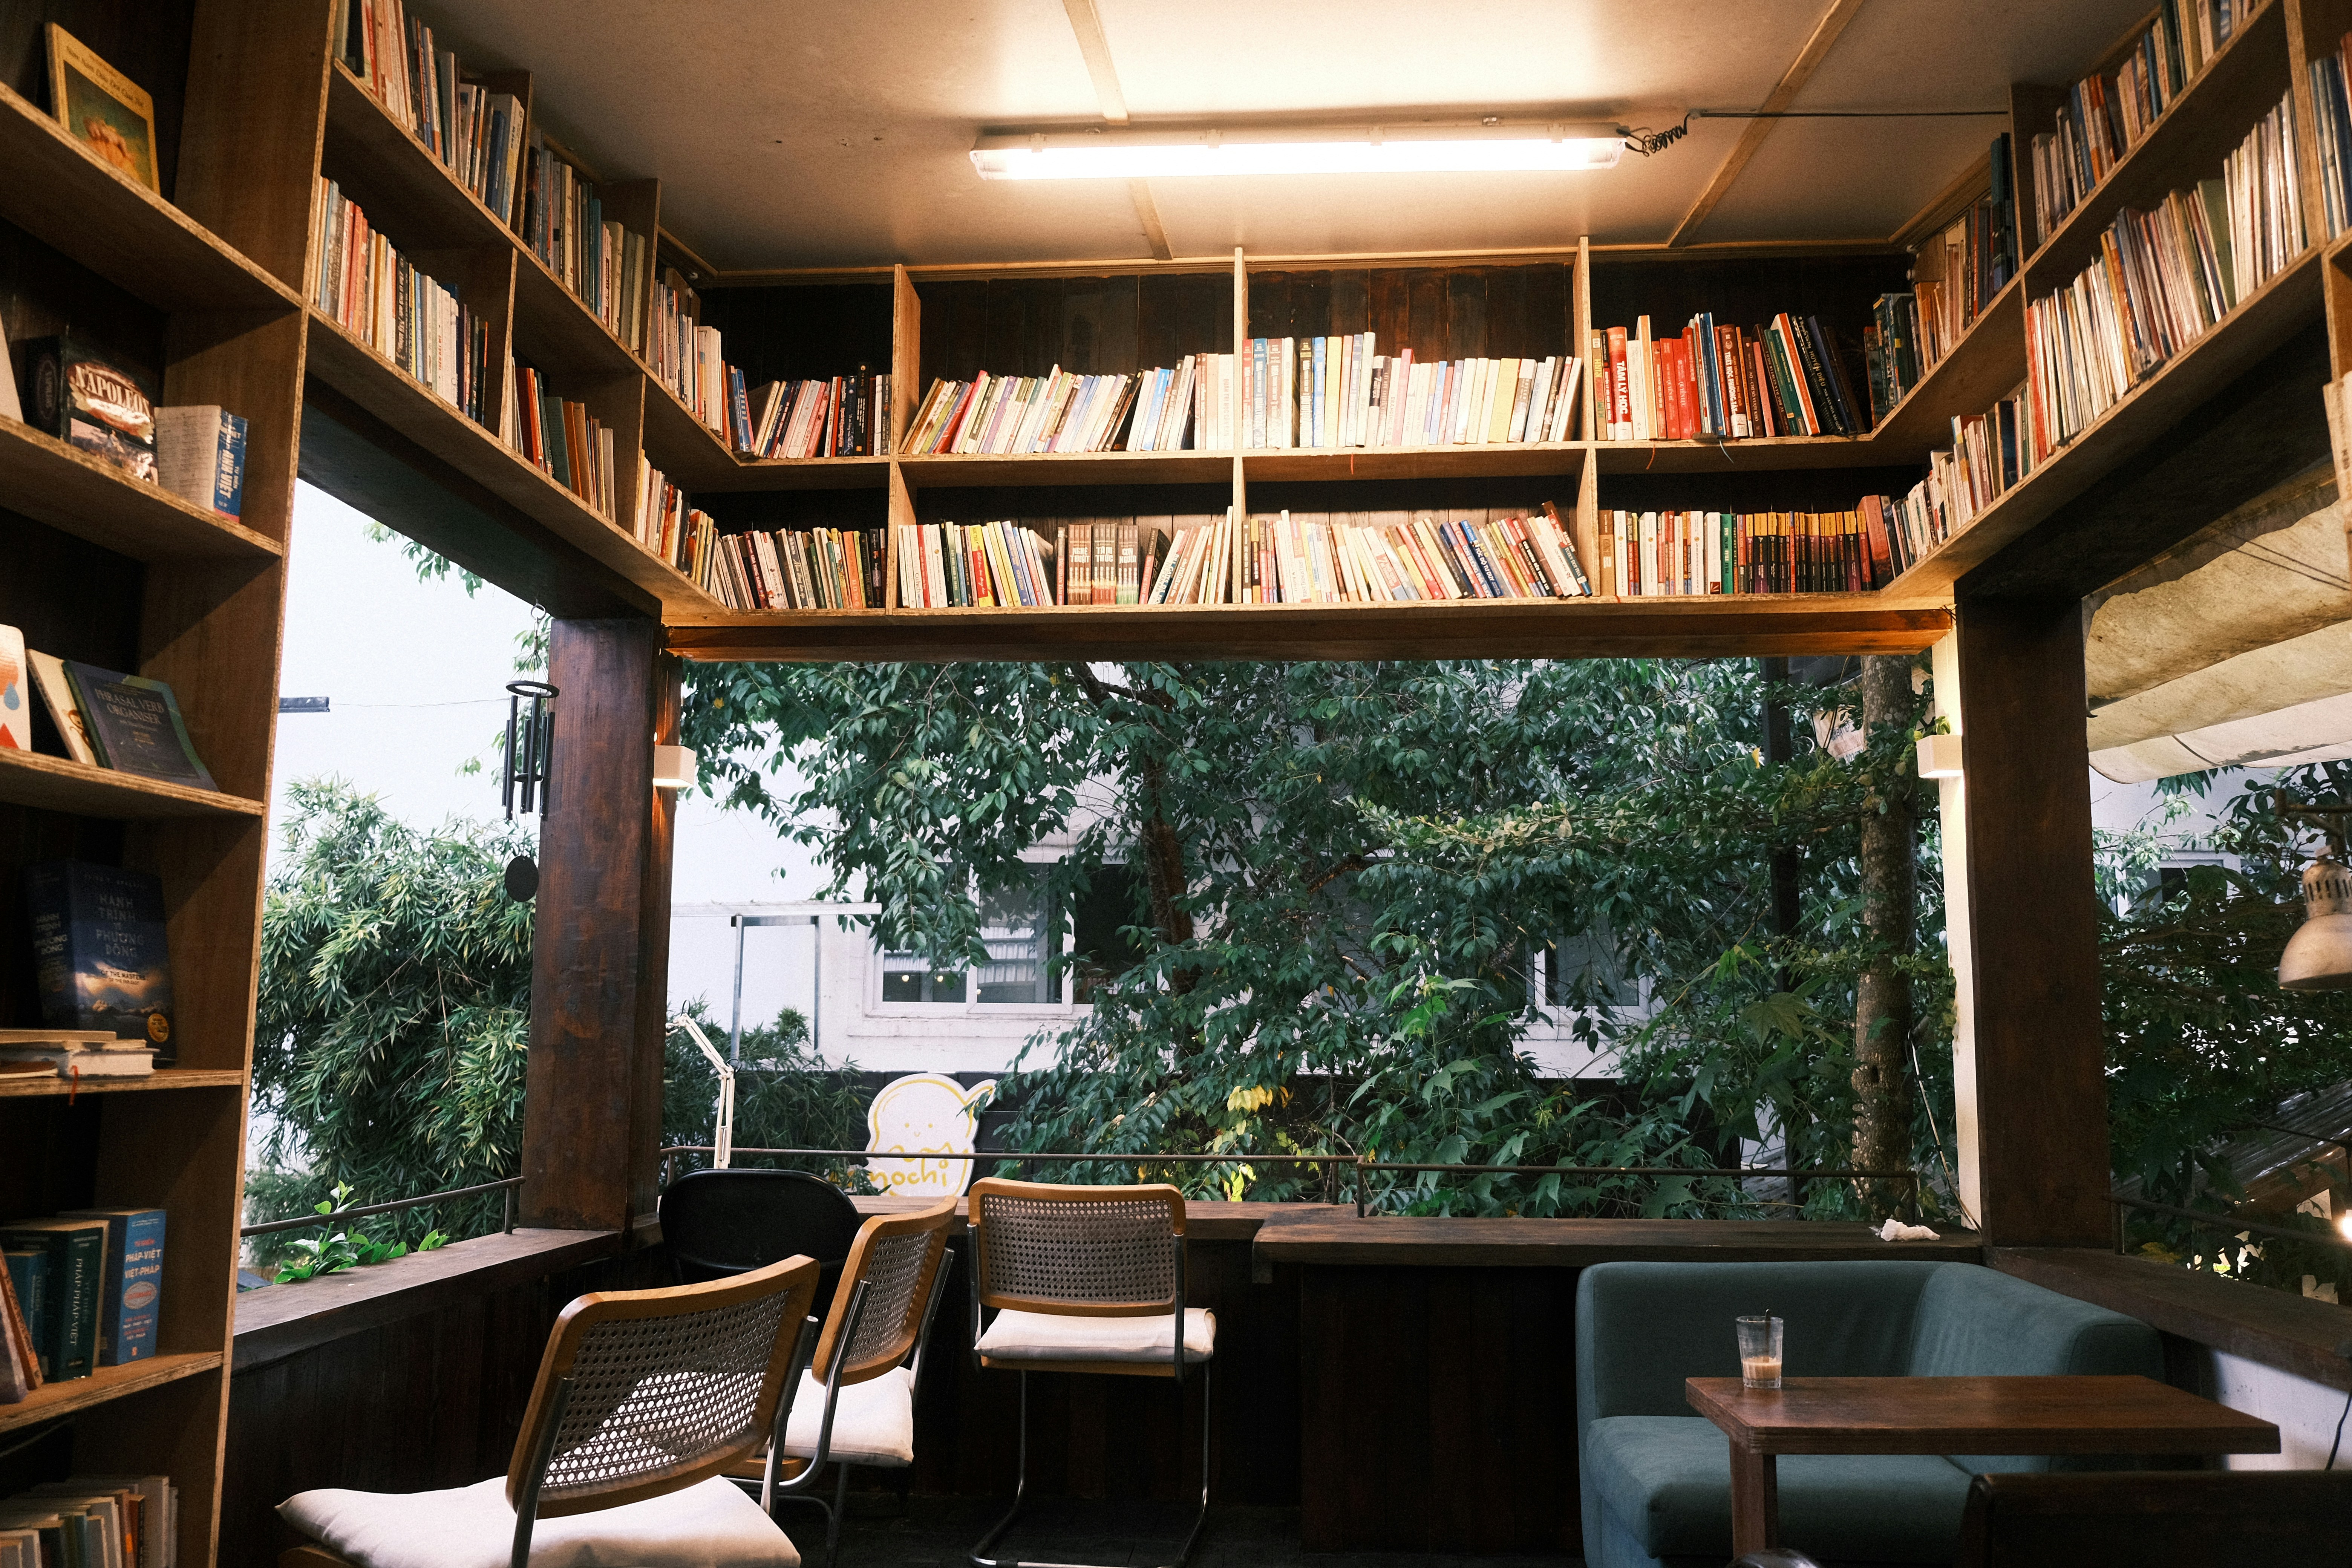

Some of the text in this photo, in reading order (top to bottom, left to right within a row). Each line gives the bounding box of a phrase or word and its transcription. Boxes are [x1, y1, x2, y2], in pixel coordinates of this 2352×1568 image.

[73, 366, 151, 416] NAPOLEON
[1616, 361, 1628, 414] TÂM LÝ HỌC
[1724, 351, 1739, 412] TRIẾT HỌC PHƯƠNG TÂY
[219, 449, 234, 498] ANH-VIỆT
[1096, 546, 1113, 554] TÂM
[1122, 548, 1133, 556] CON
[1378, 556, 1388, 565] 7
[1461, 544, 1471, 557] CON
[1475, 547, 1495, 582] TỐC ĐỘ TƯ DUY
[95, 688, 139, 709] PHRASAL
[141, 698, 164, 713] VERB
[106, 702, 162, 725] ORGANISER
[126, 1248, 162, 1263] PHÁP-VIỆT
[124, 1264, 160, 1280] VIỆT-PHÁP
